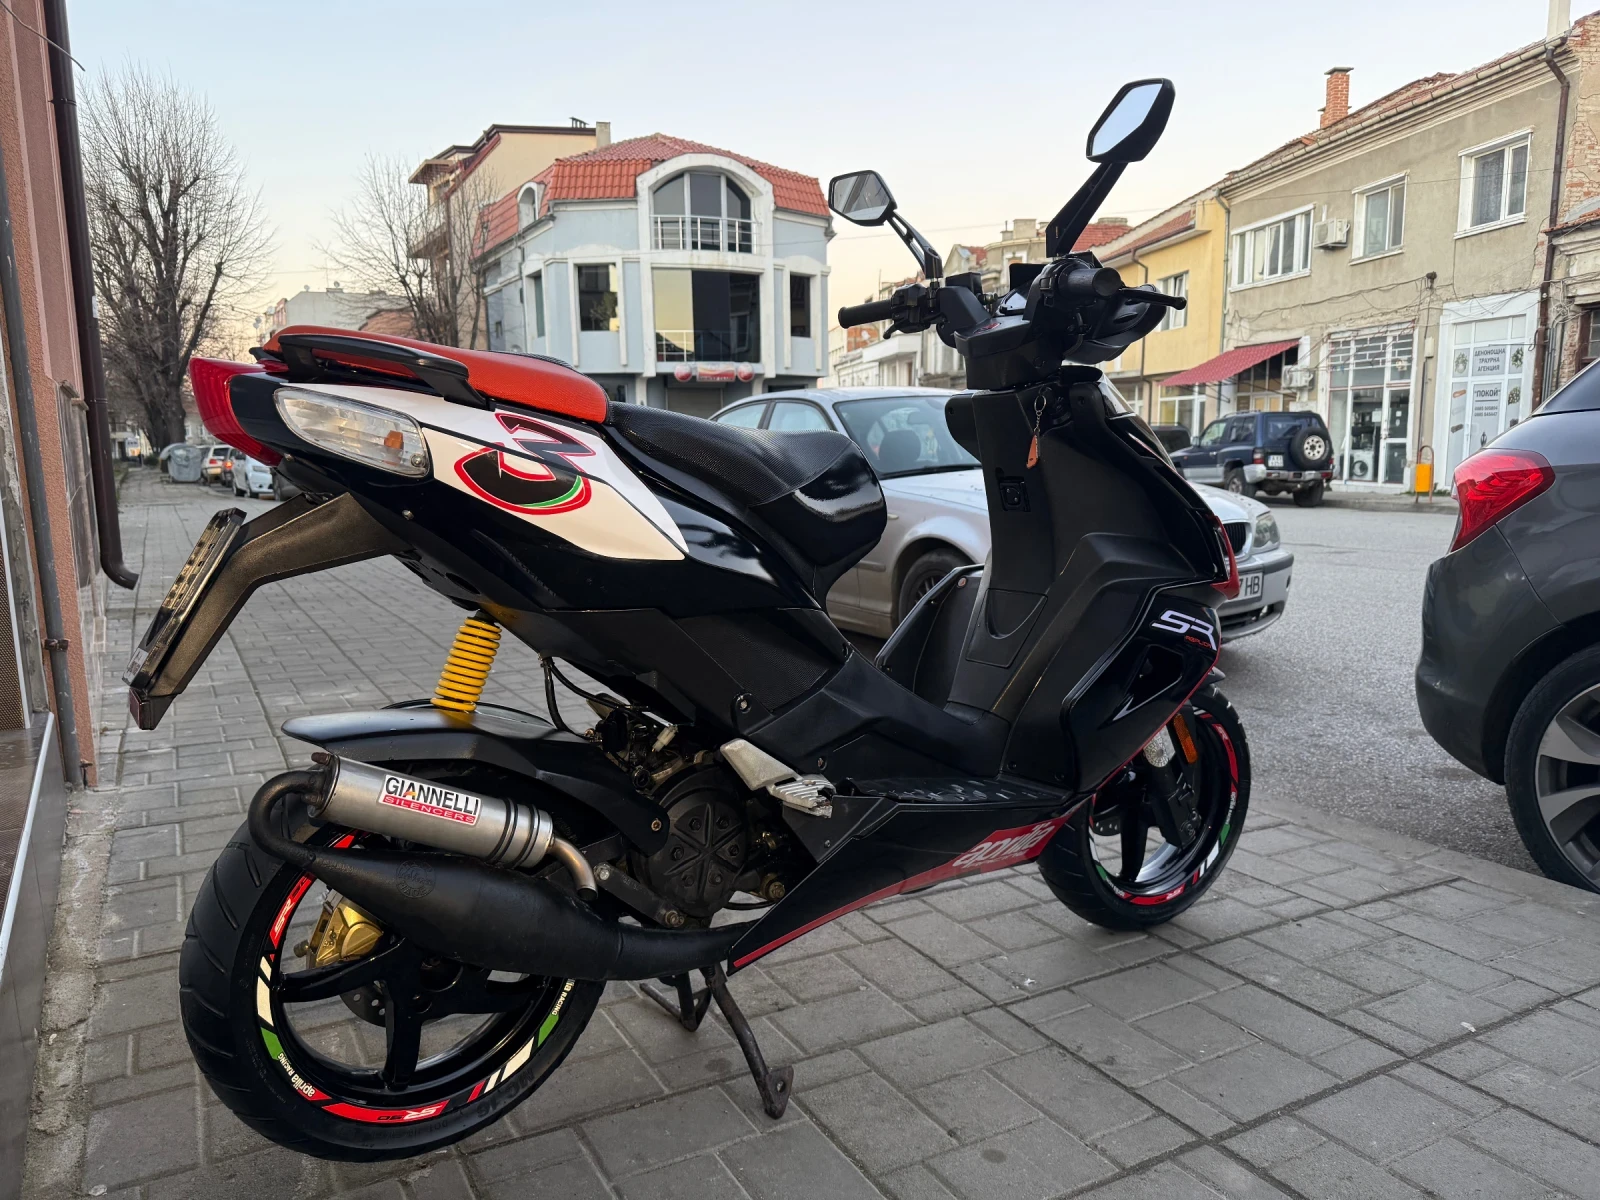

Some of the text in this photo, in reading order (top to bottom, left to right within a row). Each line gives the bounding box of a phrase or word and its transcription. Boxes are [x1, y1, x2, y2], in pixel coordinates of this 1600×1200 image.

[1474, 348, 1506, 357] ДЕНОНОЩНА
[383, 796, 475, 823] SILENCERS
[385, 776, 480, 816] GIANNELLI
[952, 821, 1056, 869] aprilia
[551, 991, 568, 1016] RACING
[277, 1052, 317, 1098] aprilia RACING
